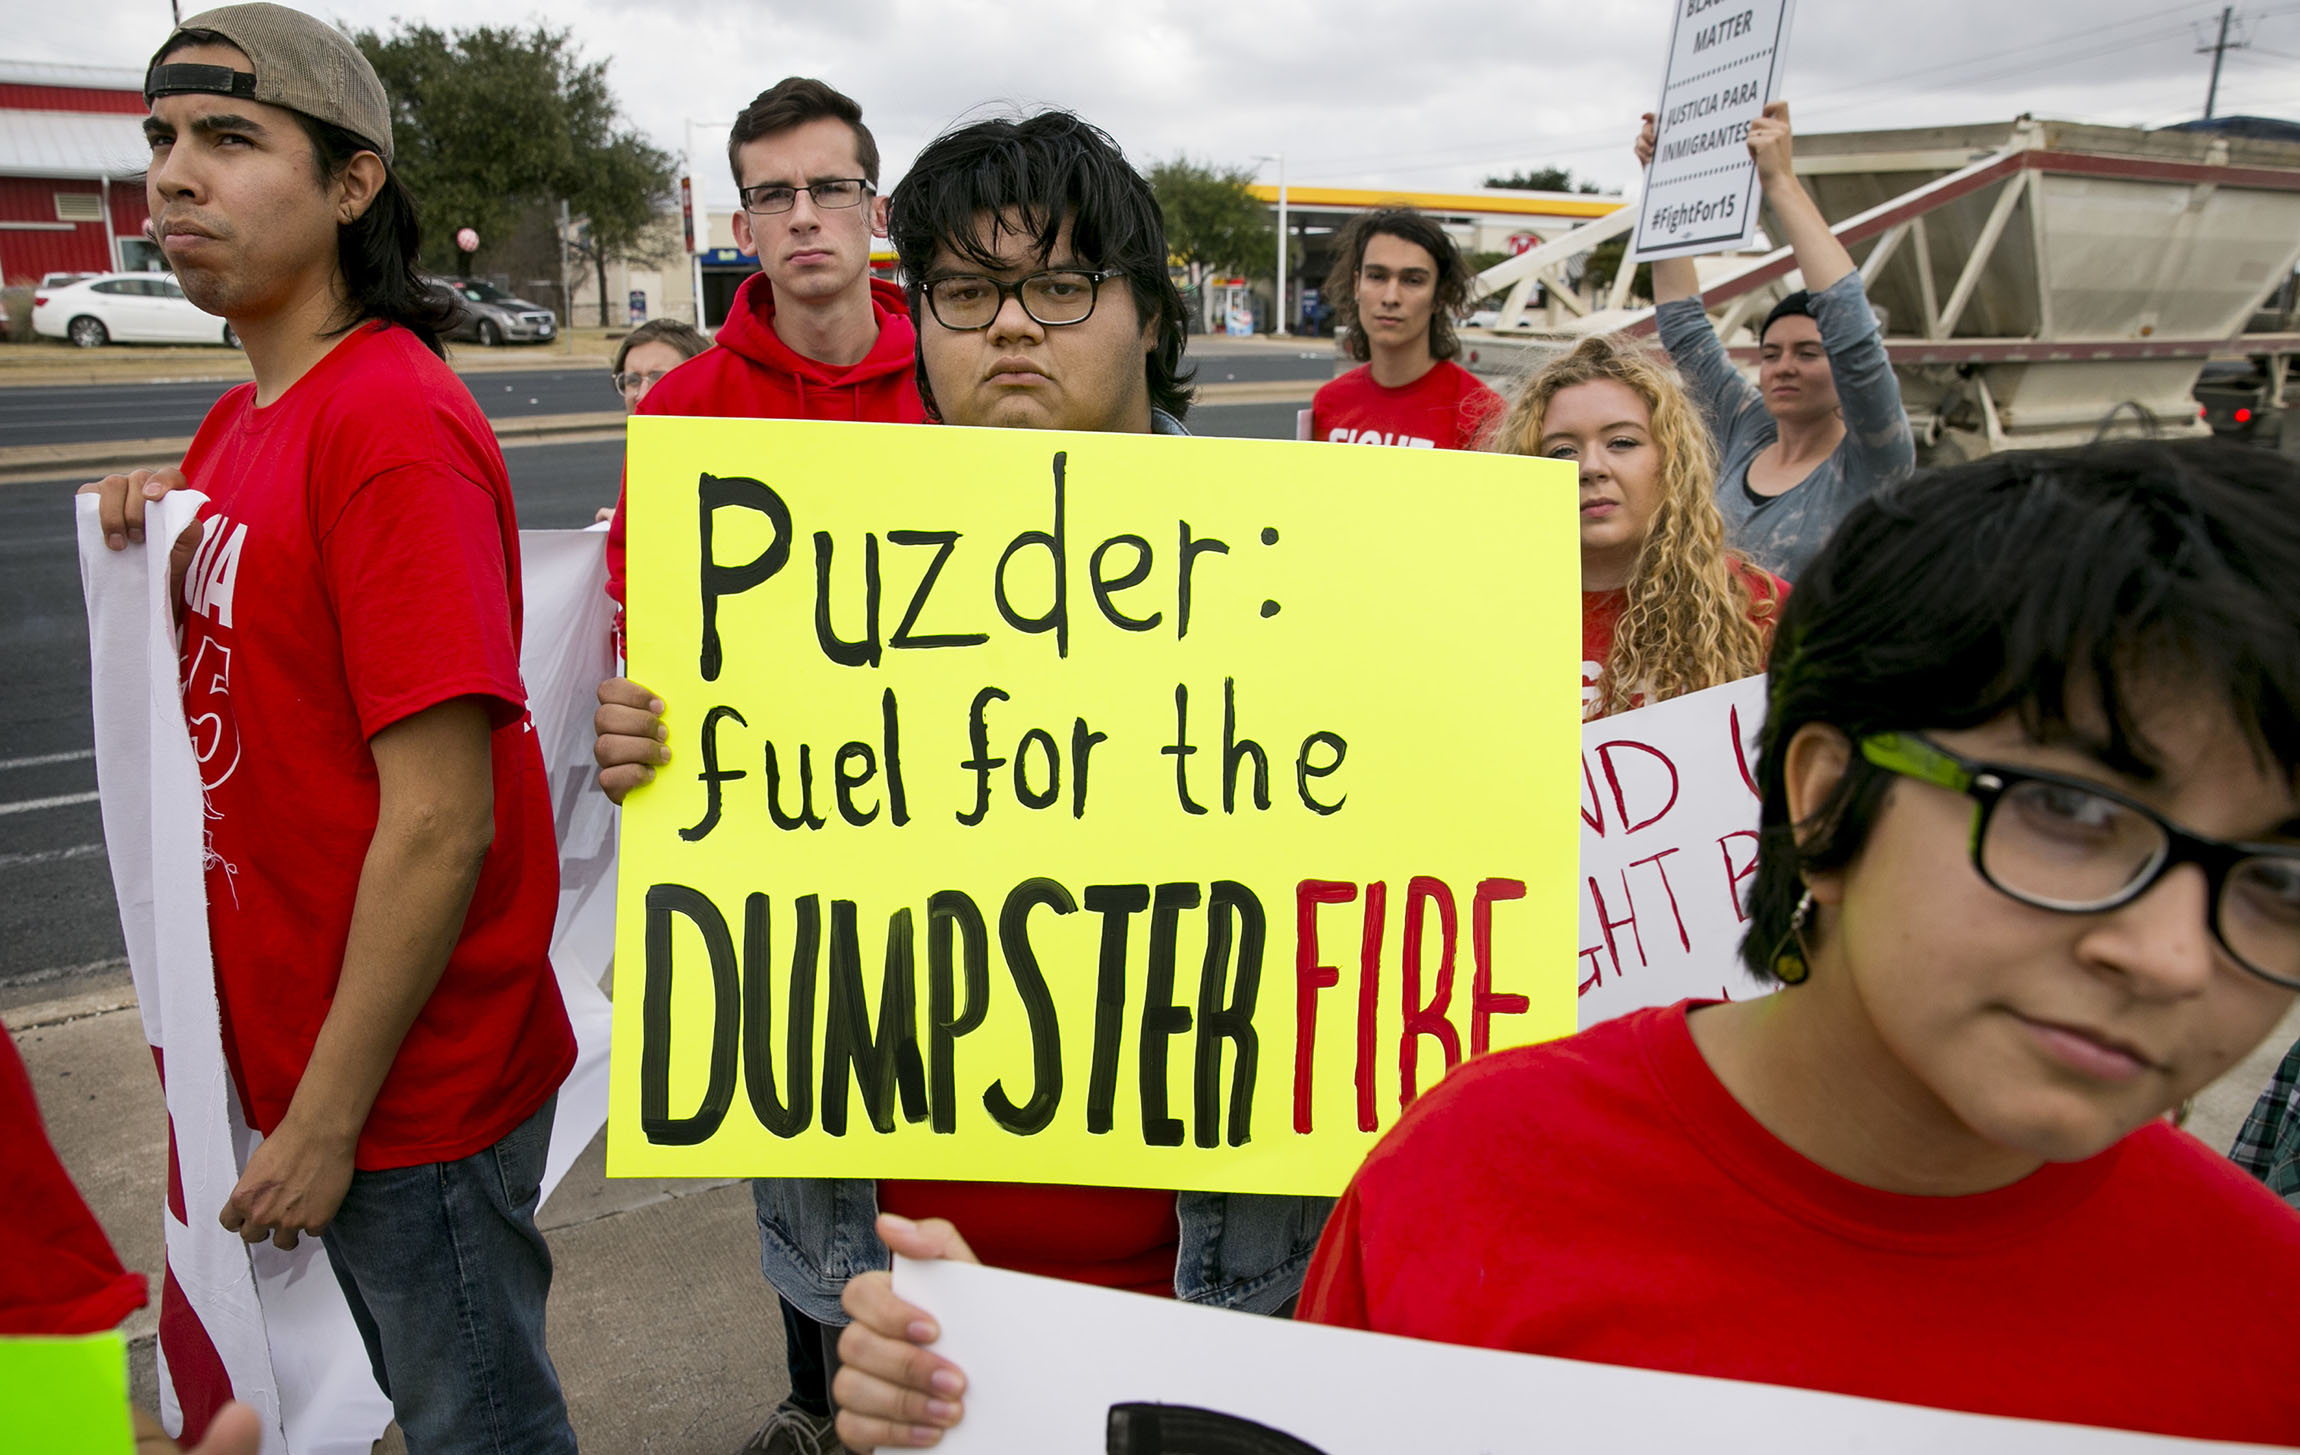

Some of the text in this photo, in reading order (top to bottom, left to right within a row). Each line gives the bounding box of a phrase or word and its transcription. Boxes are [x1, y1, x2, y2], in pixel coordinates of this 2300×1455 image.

[1693, 9, 1753, 54] MATTER
[1664, 80, 1757, 134] JUSTICIA PARA
[1662, 120, 1751, 163] INMIGRANTES
[1651, 193, 1736, 234] #FightFor15
[698, 451, 1282, 682] Puzder:
[678, 686, 911, 842] fuel
[955, 686, 1108, 827] for
[1161, 676, 1348, 816] the
[640, 875, 1531, 1149] DUMPSTER FIRE
